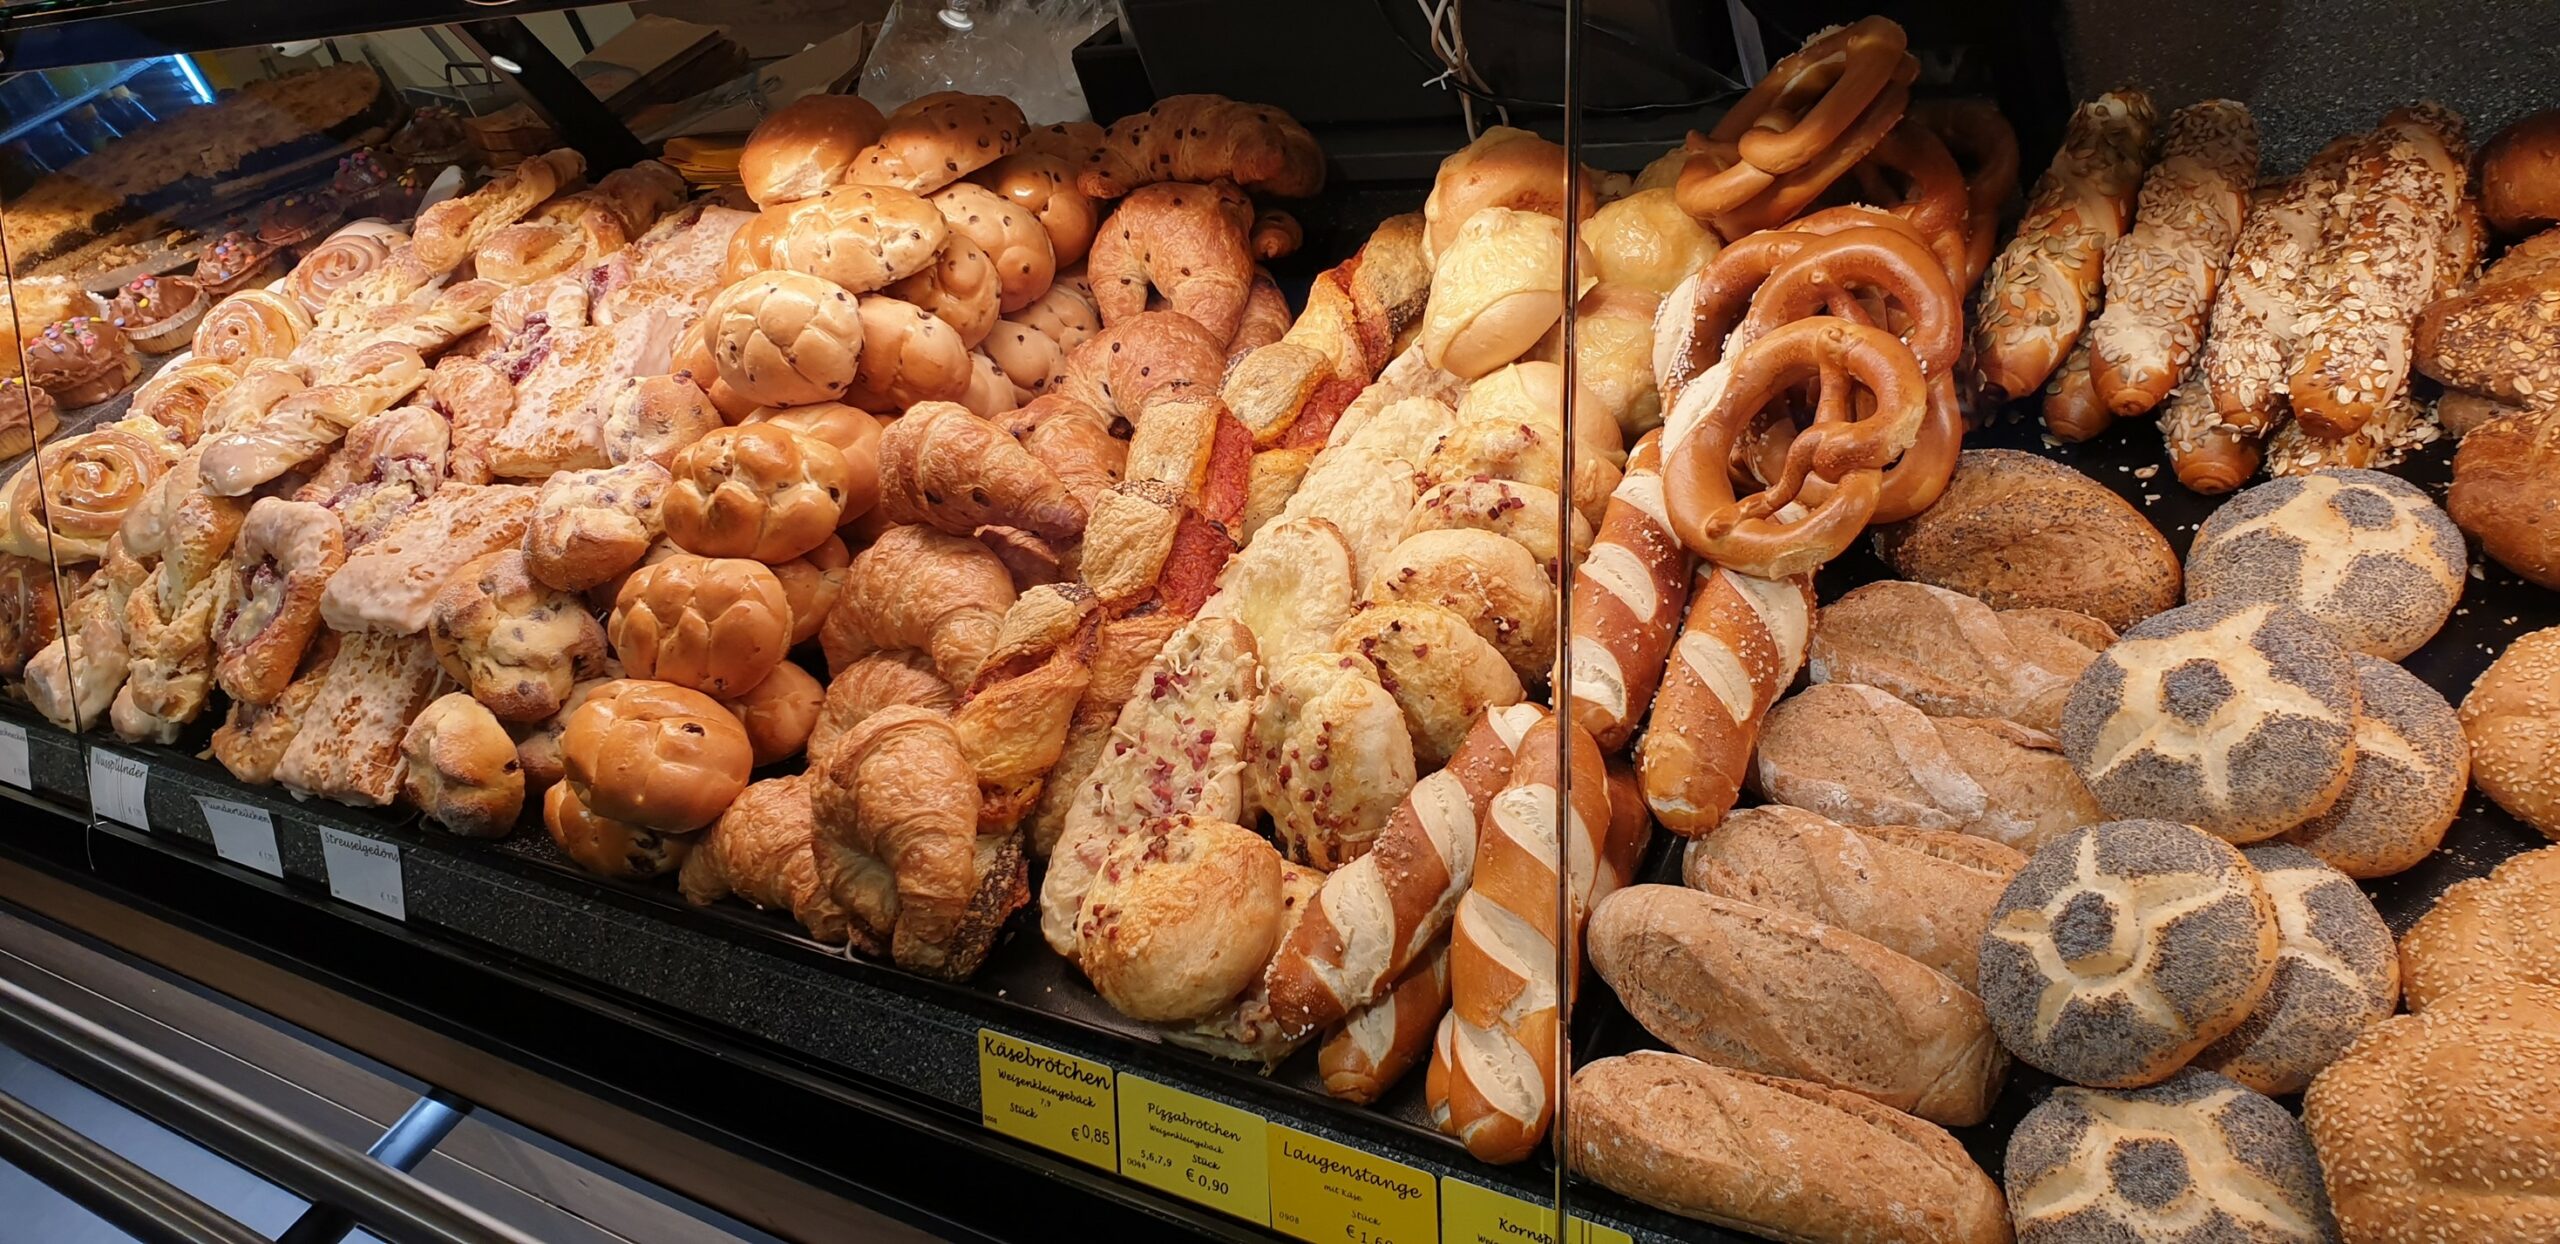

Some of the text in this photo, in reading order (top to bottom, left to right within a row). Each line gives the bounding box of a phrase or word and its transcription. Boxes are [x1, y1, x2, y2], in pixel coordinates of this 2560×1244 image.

[983, 1036, 1112, 1091] Käsebrötchen
[998, 1068, 1096, 1108] Weizenkleingebäck
[1009, 1102, 1039, 1119] Stück
[1146, 1101, 1242, 1143] Pizzabrötchen
[1071, 1124, 1111, 1146] € 0,85
[1140, 1149, 1174, 1168] 5,6,7,9
[1191, 1154, 1221, 1171] Stück
[1283, 1141, 1423, 1201] Laugenstange
[1185, 1167, 1230, 1196] € 0,90
[1346, 1223, 1356, 1239] €
